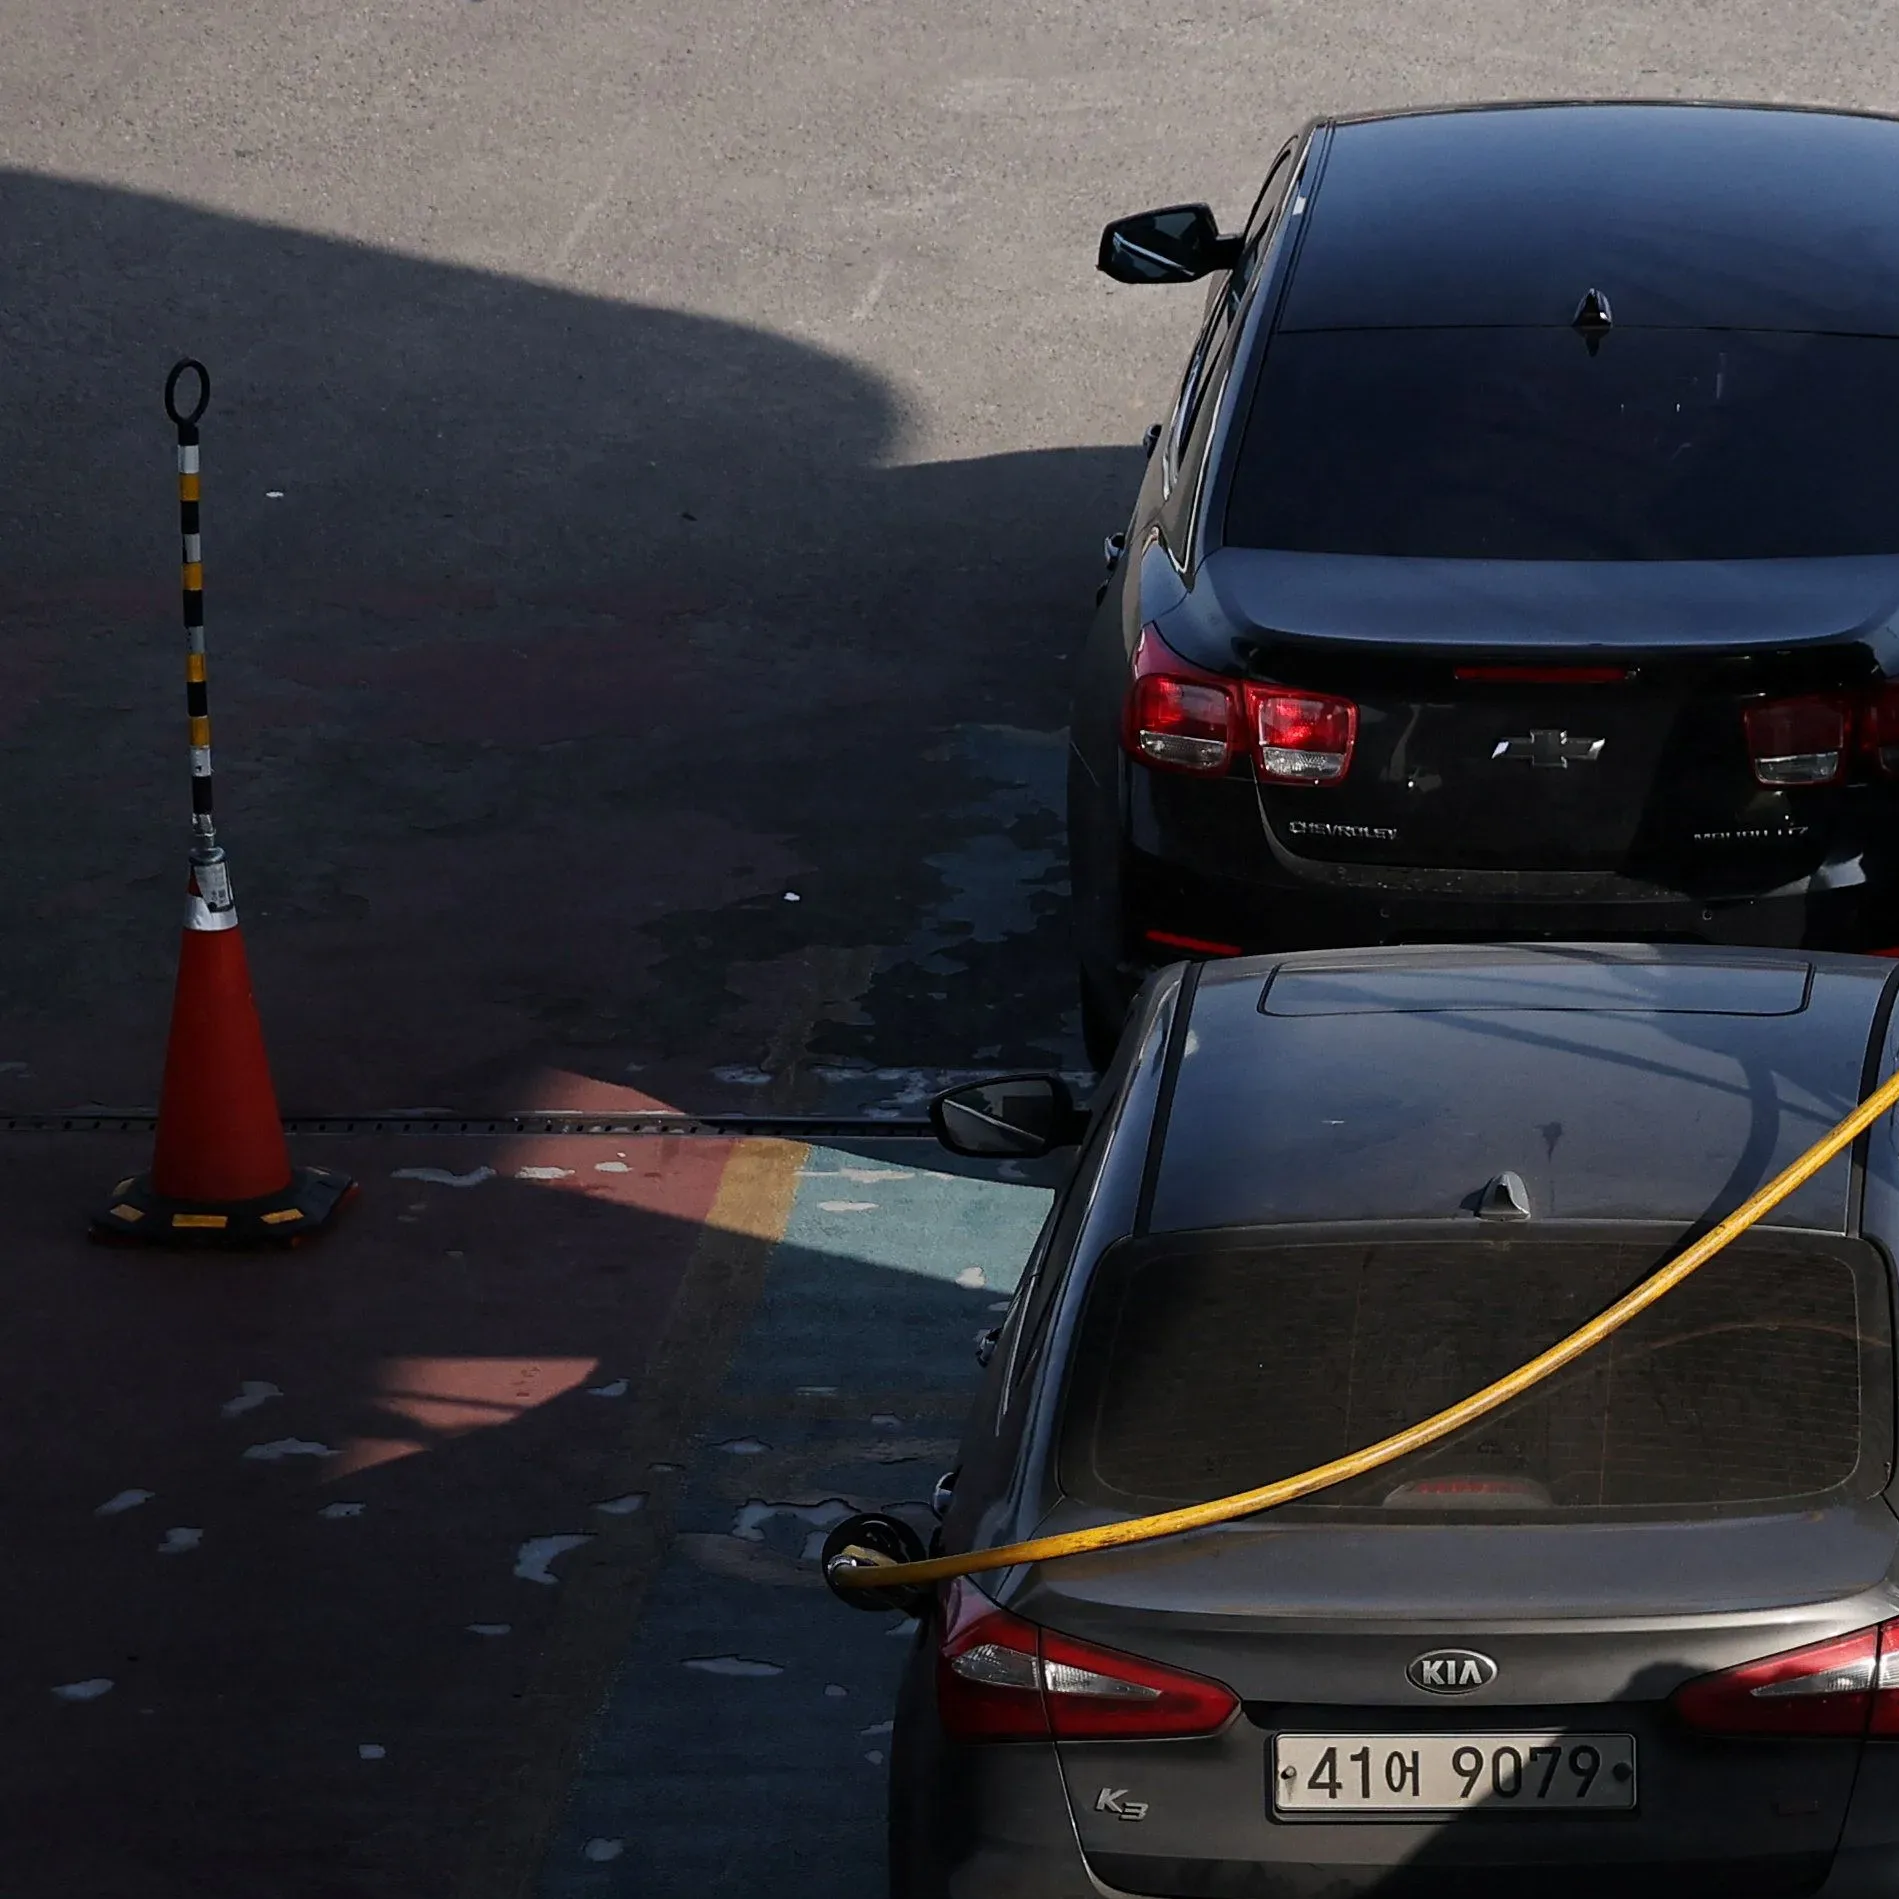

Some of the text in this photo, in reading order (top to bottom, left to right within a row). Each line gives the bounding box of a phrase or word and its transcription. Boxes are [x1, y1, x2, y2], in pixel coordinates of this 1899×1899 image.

[1421, 1660, 1483, 1685] KIA
[1307, 1745, 1601, 1799] 41어 9079
[1095, 1787, 1150, 1822] K3
